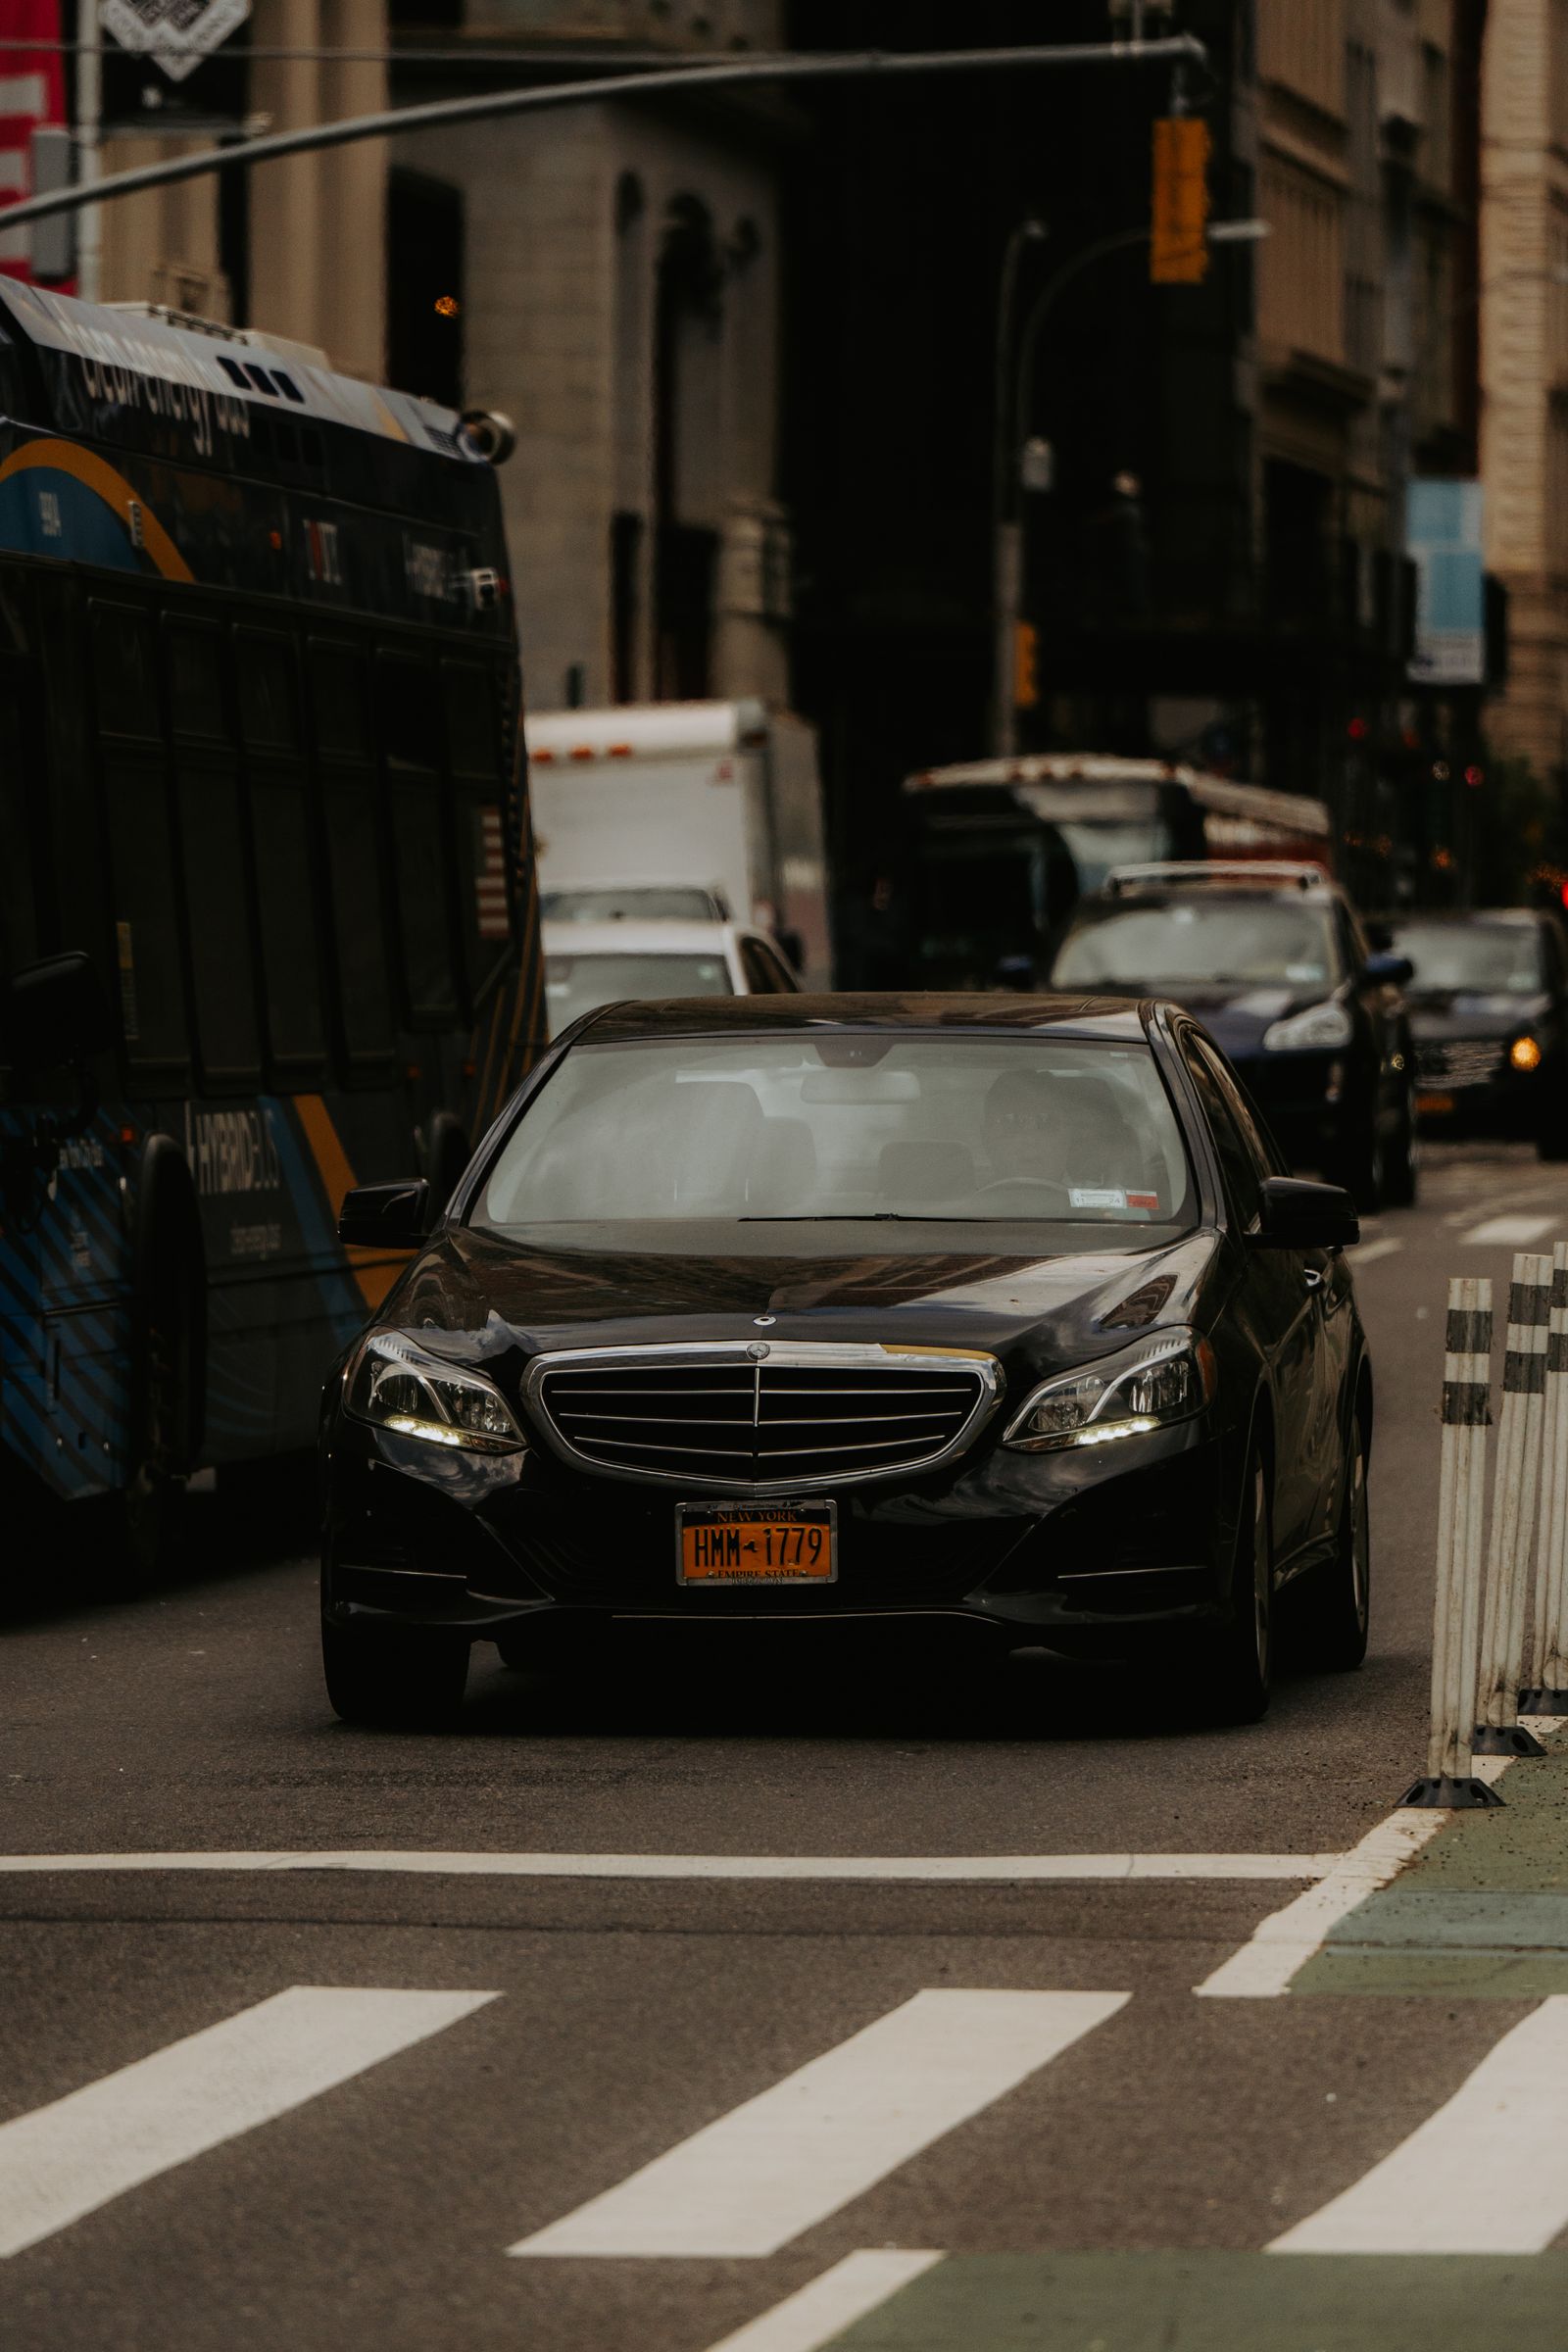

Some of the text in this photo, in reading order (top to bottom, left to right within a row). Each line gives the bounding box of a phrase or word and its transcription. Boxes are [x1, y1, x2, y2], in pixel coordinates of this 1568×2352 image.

[716, 1510, 798, 1522] NEW YORK
[695, 1527, 822, 1567] HMM 1779
